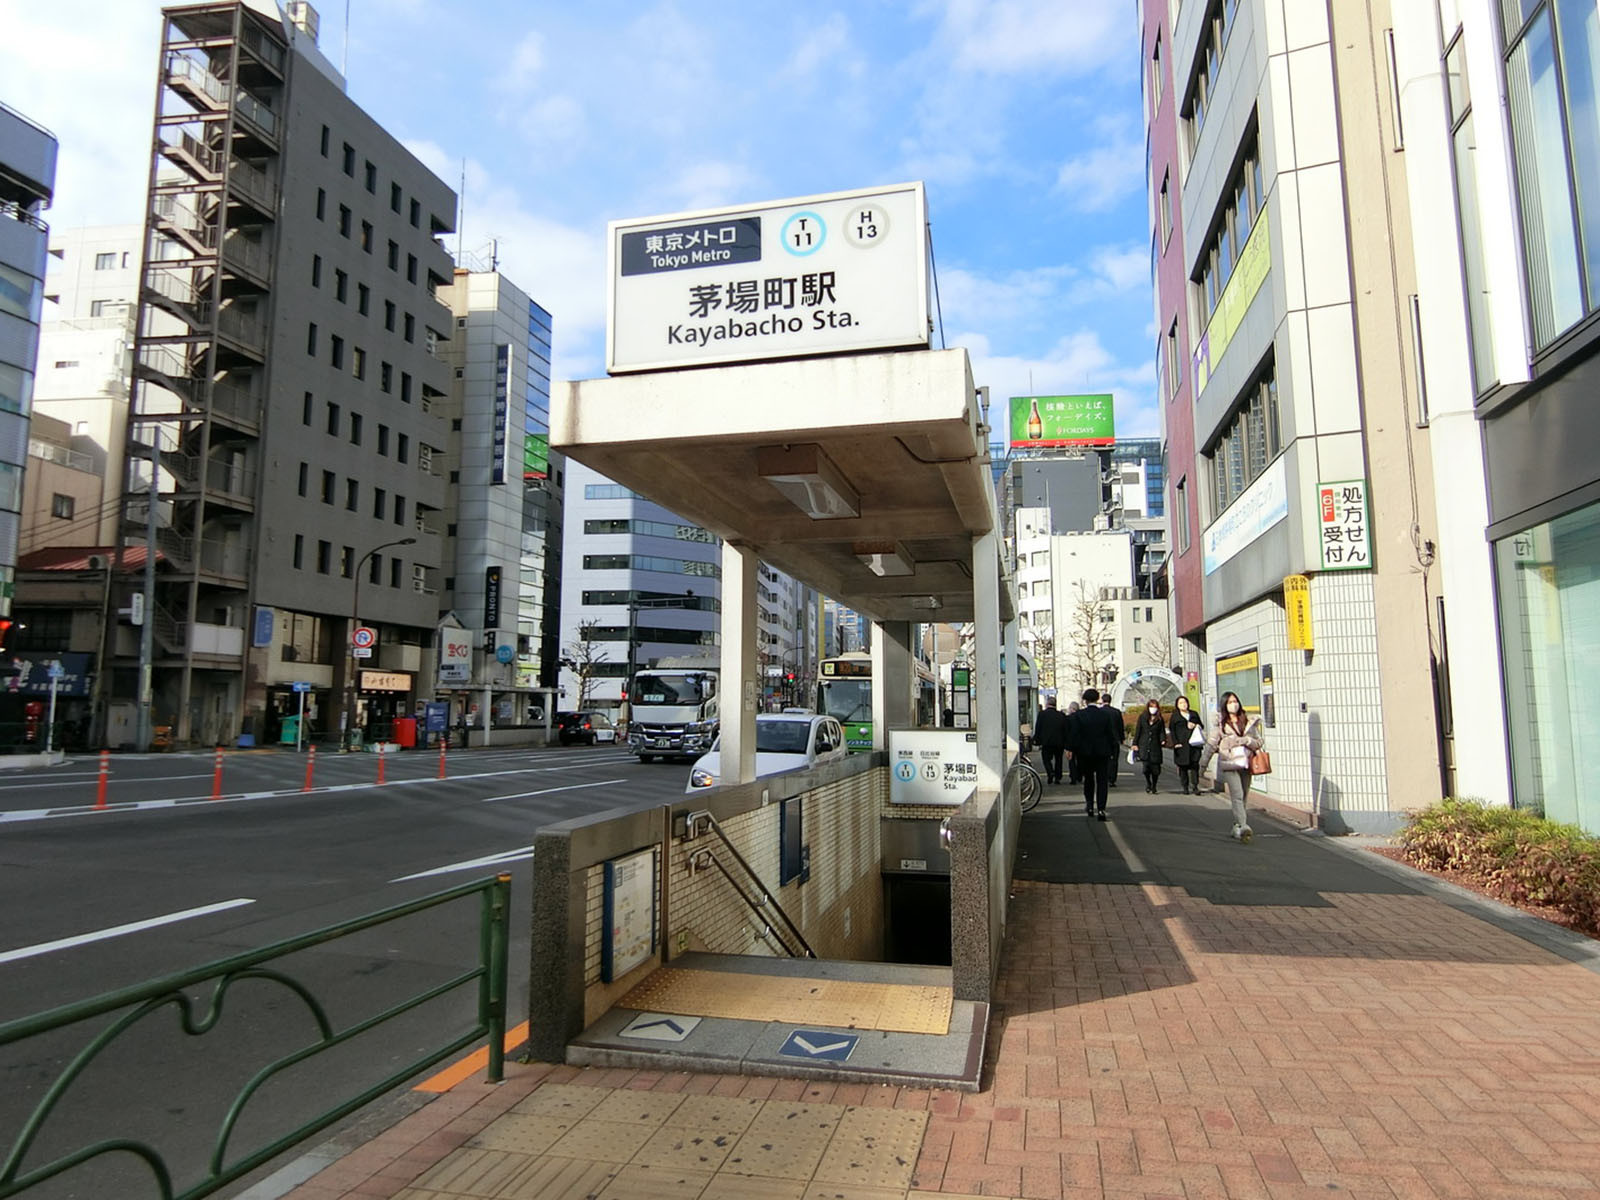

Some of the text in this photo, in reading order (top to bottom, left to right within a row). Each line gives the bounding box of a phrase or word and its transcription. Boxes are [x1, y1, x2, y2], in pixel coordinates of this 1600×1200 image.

[799, 219, 808, 231] T
[860, 210, 873, 224] H
[645, 227, 736, 254] 東京メトロ
[794, 233, 812, 247] 11
[857, 225, 878, 239] 13
[650, 248, 731, 269] Tokyo Metro
[689, 271, 836, 318] 茅場町駅
[667, 310, 859, 347] Kayabacho Sta.
[1322, 494, 1333, 517] 6F
[1342, 487, 1366, 562] 処方せん
[1323, 525, 1344, 563] 受付
[488, 585, 497, 621] PRONTO
